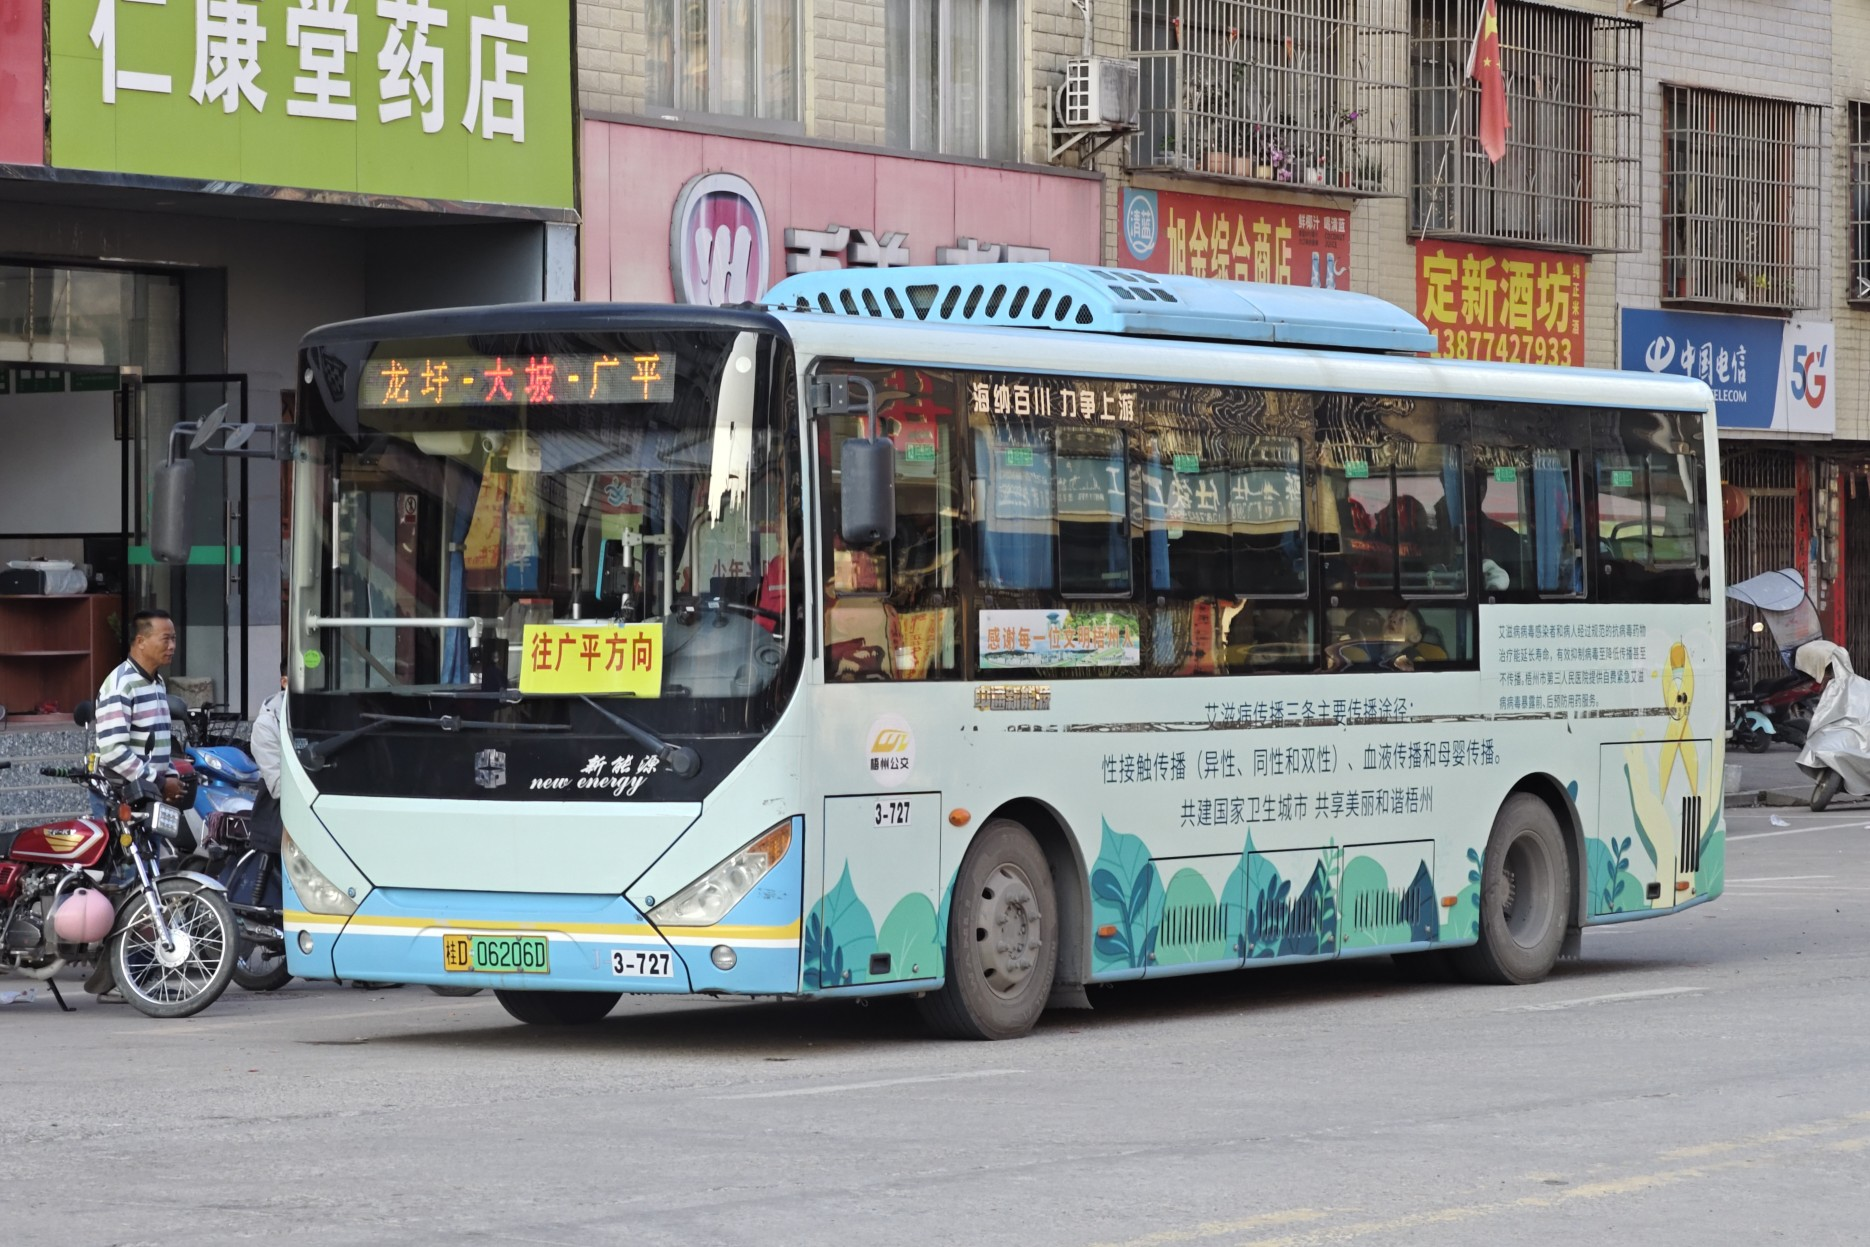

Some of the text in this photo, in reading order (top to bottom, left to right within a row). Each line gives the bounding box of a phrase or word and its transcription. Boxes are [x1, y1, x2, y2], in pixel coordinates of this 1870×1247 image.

[88, 0, 529, 142] 仁康堂药店
[1422, 249, 1571, 334] 定新酒坊
[1680, 338, 1747, 386] 中国电信
[1790, 344, 1838, 409] 5G
[973, 382, 1135, 422] 海纳百川 力争上游
[531, 631, 653, 672] 往广平方向
[987, 623, 1135, 651] 感谢每一位文明梧州人
[580, 754, 661, 775] 新能源
[870, 757, 909, 771] 梧州公交
[530, 776, 648, 796] new energy
[875, 801, 910, 825] 3-727
[1180, 785, 1434, 827] 共建国家卫生城市 共享美丽和谐梧州
[477, 941, 546, 968] 06206D
[613, 952, 670, 975] 3-727
